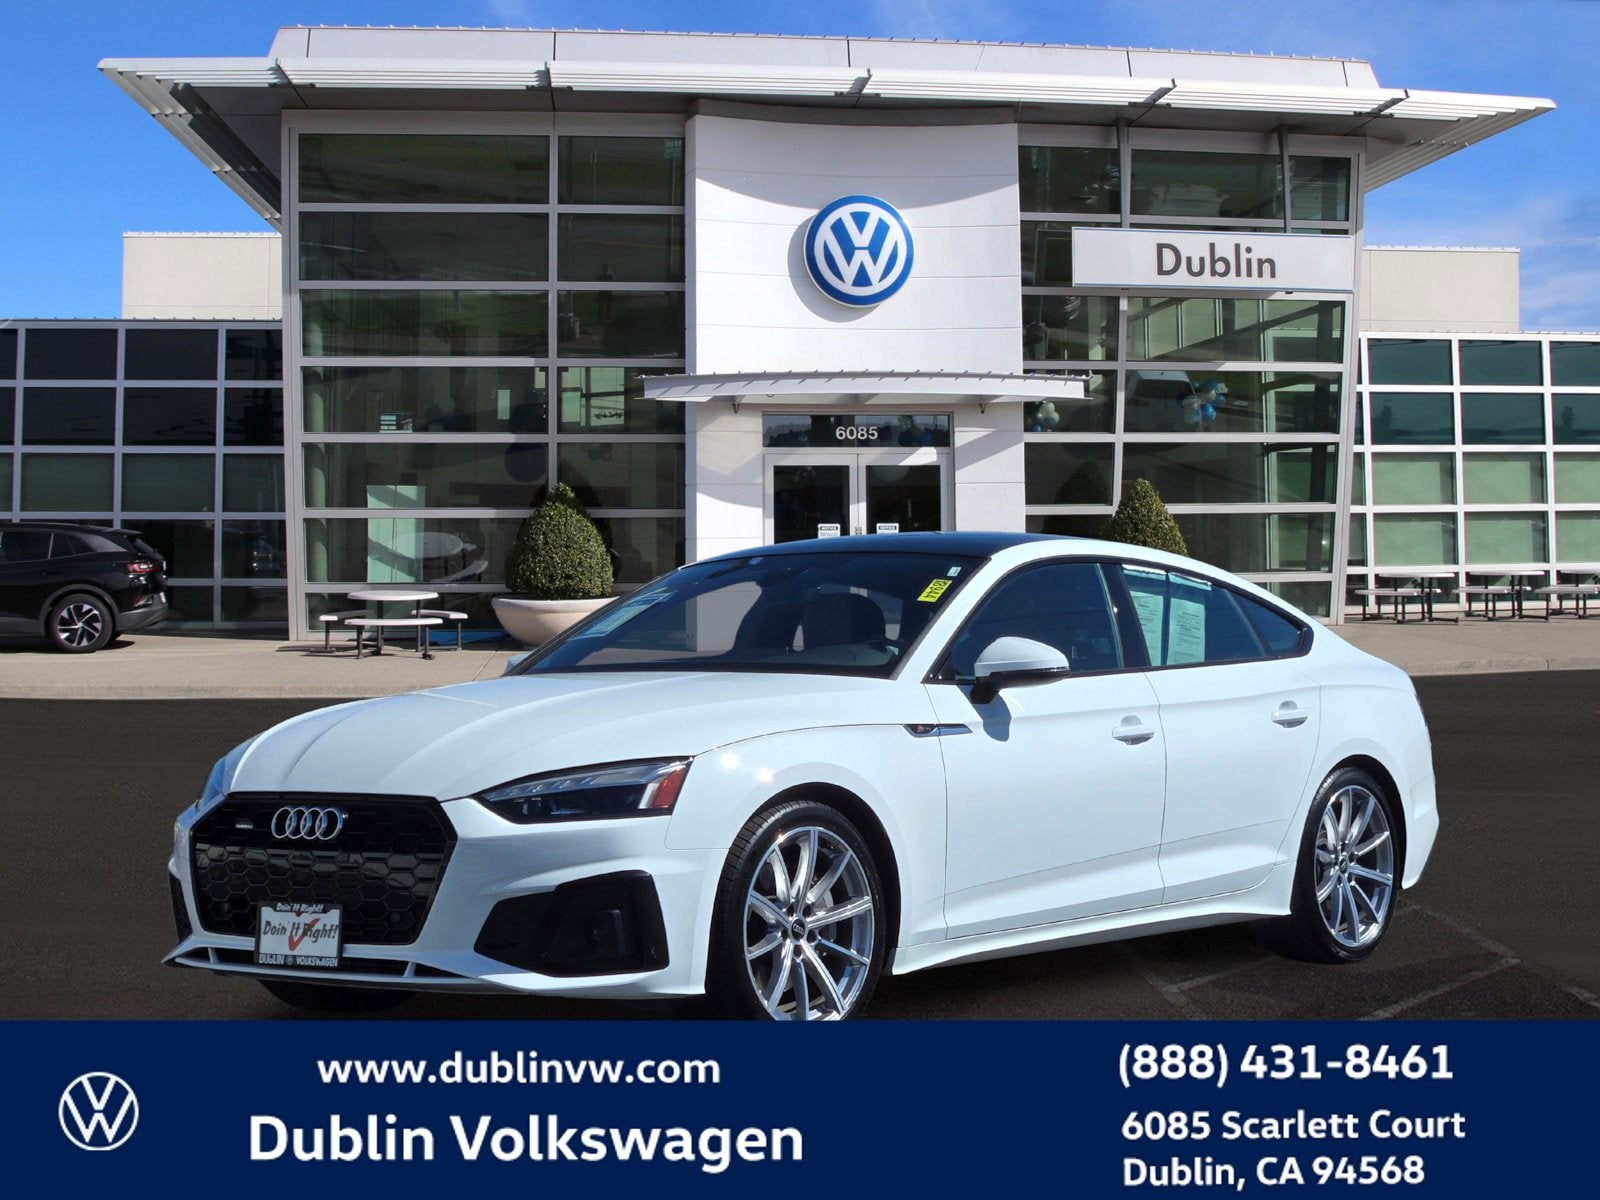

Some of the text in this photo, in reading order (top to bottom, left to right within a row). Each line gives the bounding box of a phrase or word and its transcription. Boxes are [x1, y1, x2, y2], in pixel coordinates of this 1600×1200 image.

[1156, 242, 1276, 279] Dublin
[835, 426, 879, 440] 6085
[291, 921, 301, 937] It
[303, 922, 339, 943] Right!
[259, 953, 338, 967] DUBLIN VOLKSWAGEN
